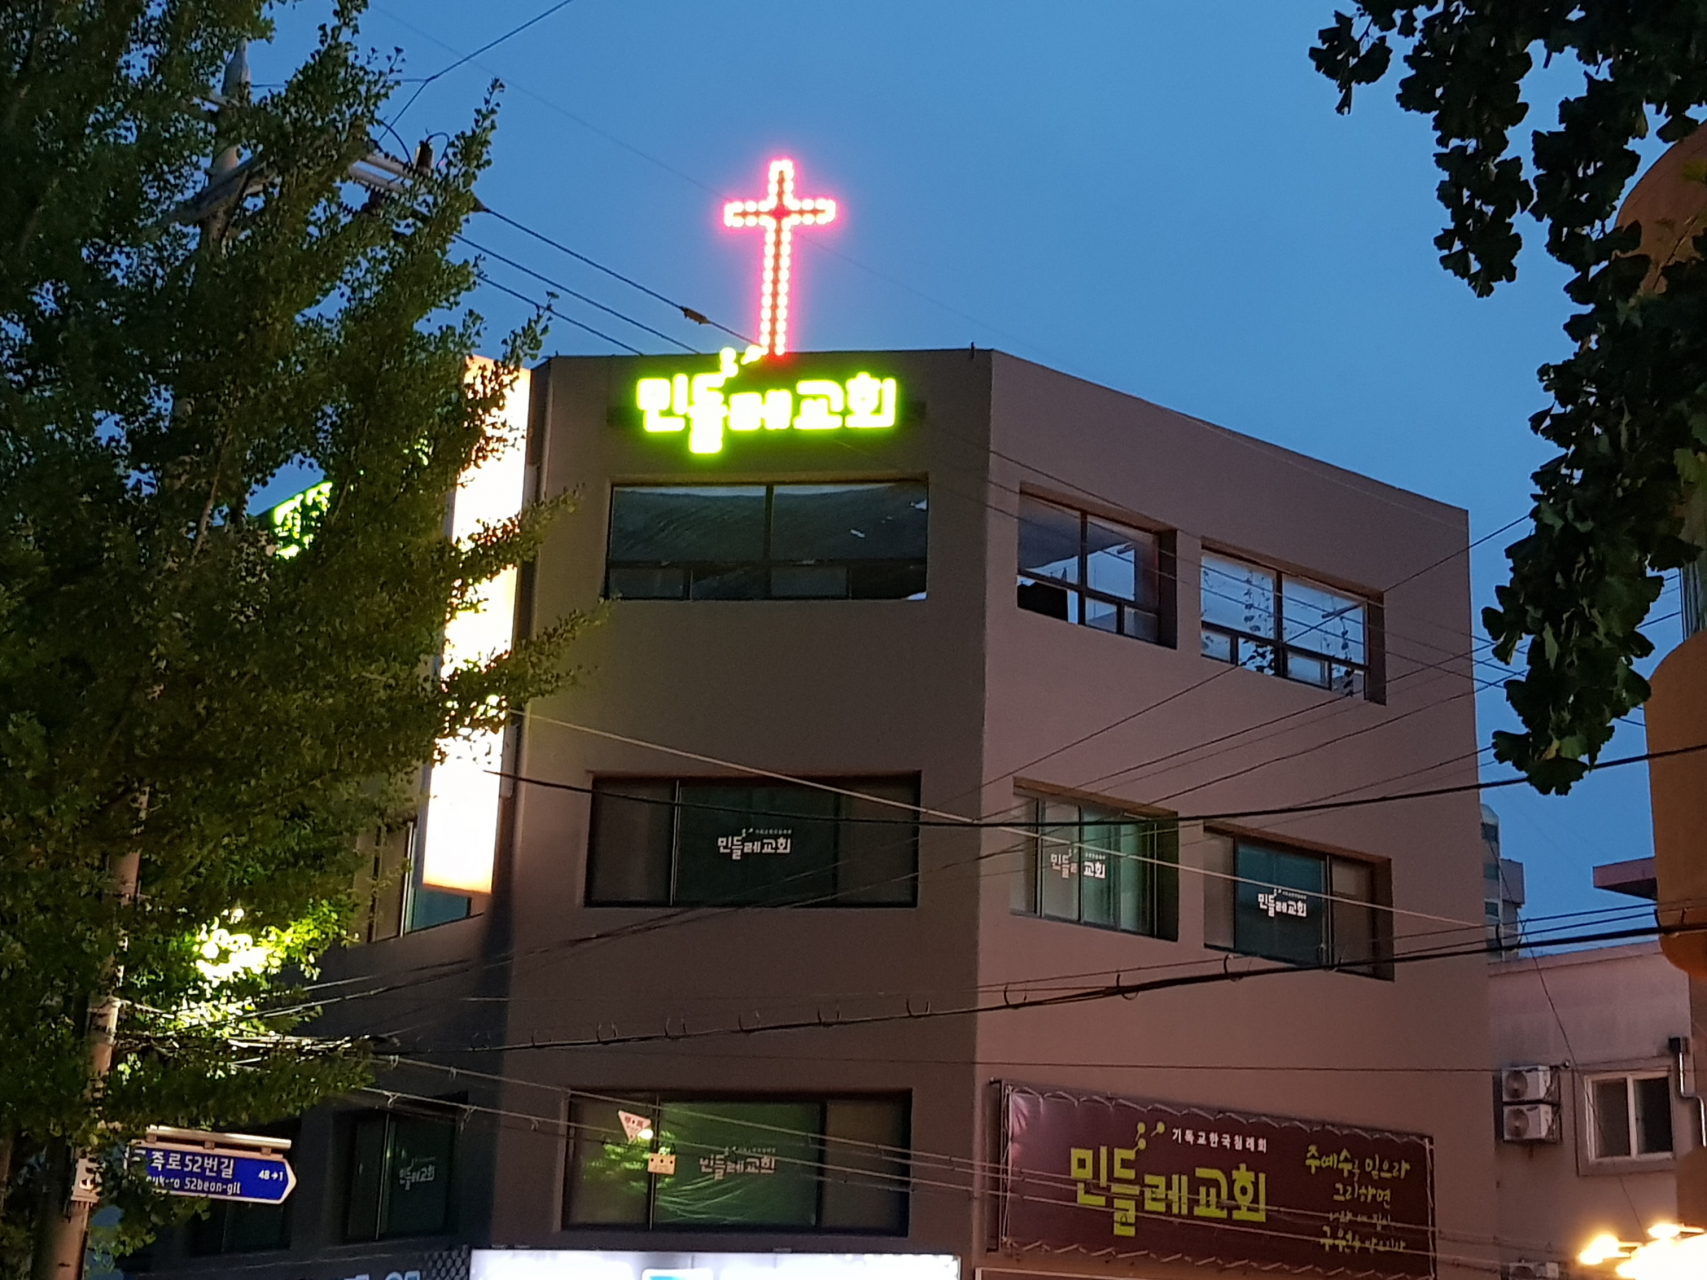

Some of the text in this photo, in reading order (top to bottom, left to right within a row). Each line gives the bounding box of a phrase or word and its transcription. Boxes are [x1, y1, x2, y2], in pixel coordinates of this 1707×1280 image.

[635, 369, 897, 455] 민들레교회
[717, 835, 791, 860] 민들레교회
[1257, 893, 1307, 917] 민들레교회
[1172, 1127, 1267, 1154] 기독교한국침례회
[258, 1170, 284, 1182] 48 1
[700, 1153, 775, 1180] 민들레교회
[183, 1177, 242, 1195] 52beon-gil
[1070, 1145, 1266, 1237] 민들레교회
[1332, 1182, 1391, 1209] 그리하면
